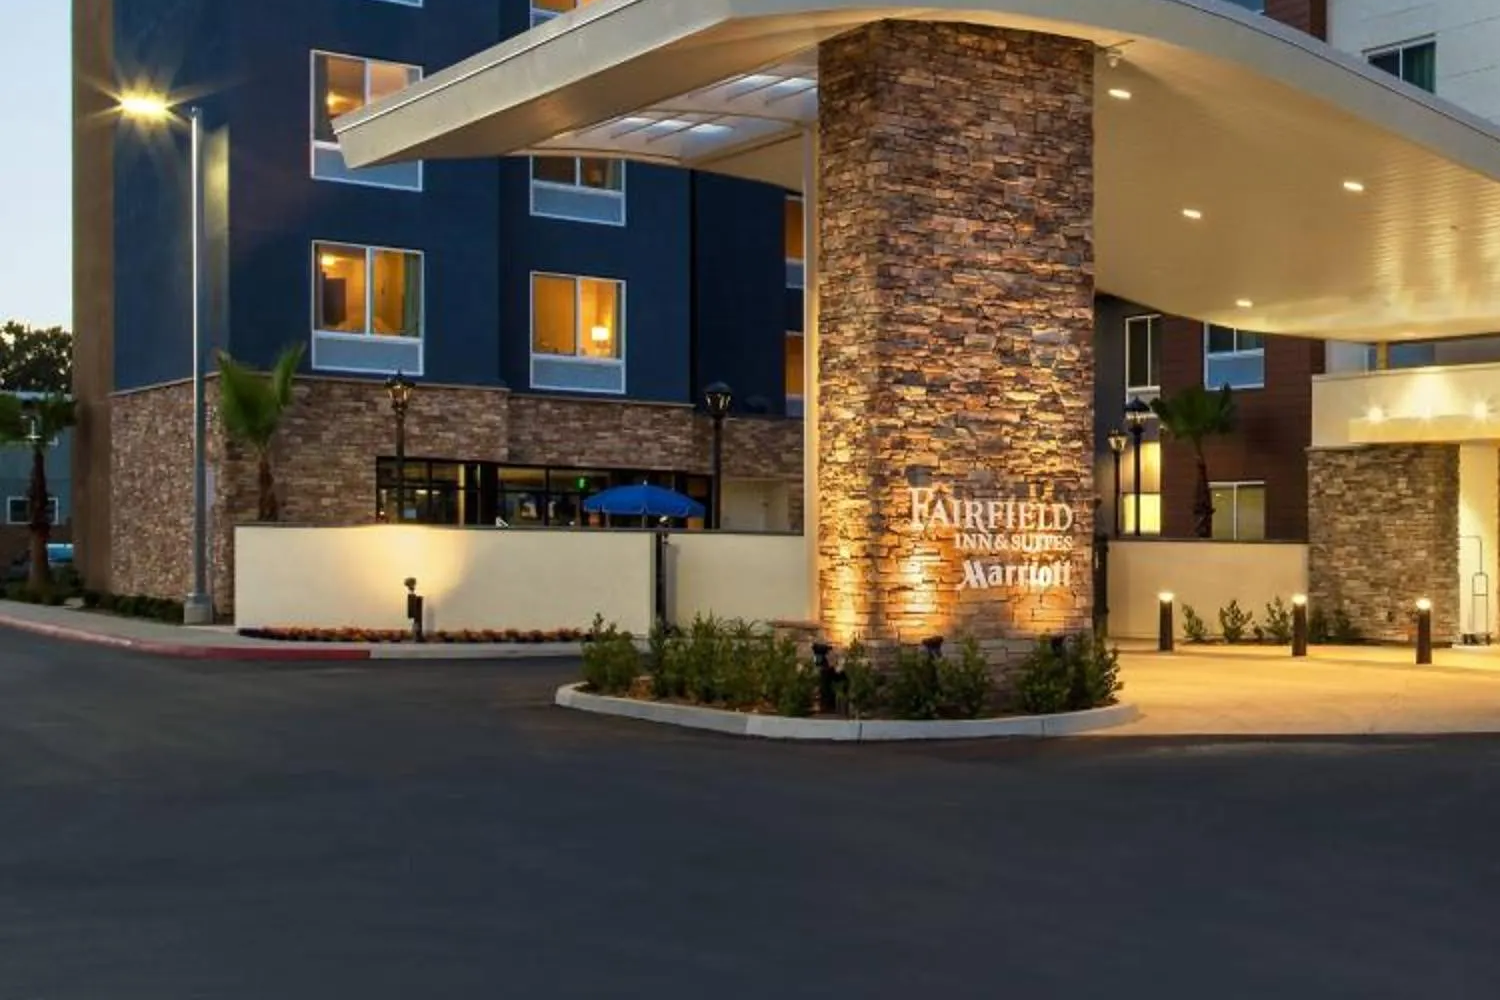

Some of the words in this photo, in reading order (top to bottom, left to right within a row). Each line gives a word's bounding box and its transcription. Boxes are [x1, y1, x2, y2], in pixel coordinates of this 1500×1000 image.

[909, 486, 1073, 532] FAIRFIELD
[955, 532, 993, 550] INN
[994, 532, 1009, 551] &
[1010, 533, 1073, 552] SUITES
[956, 559, 1072, 590] Marriott
